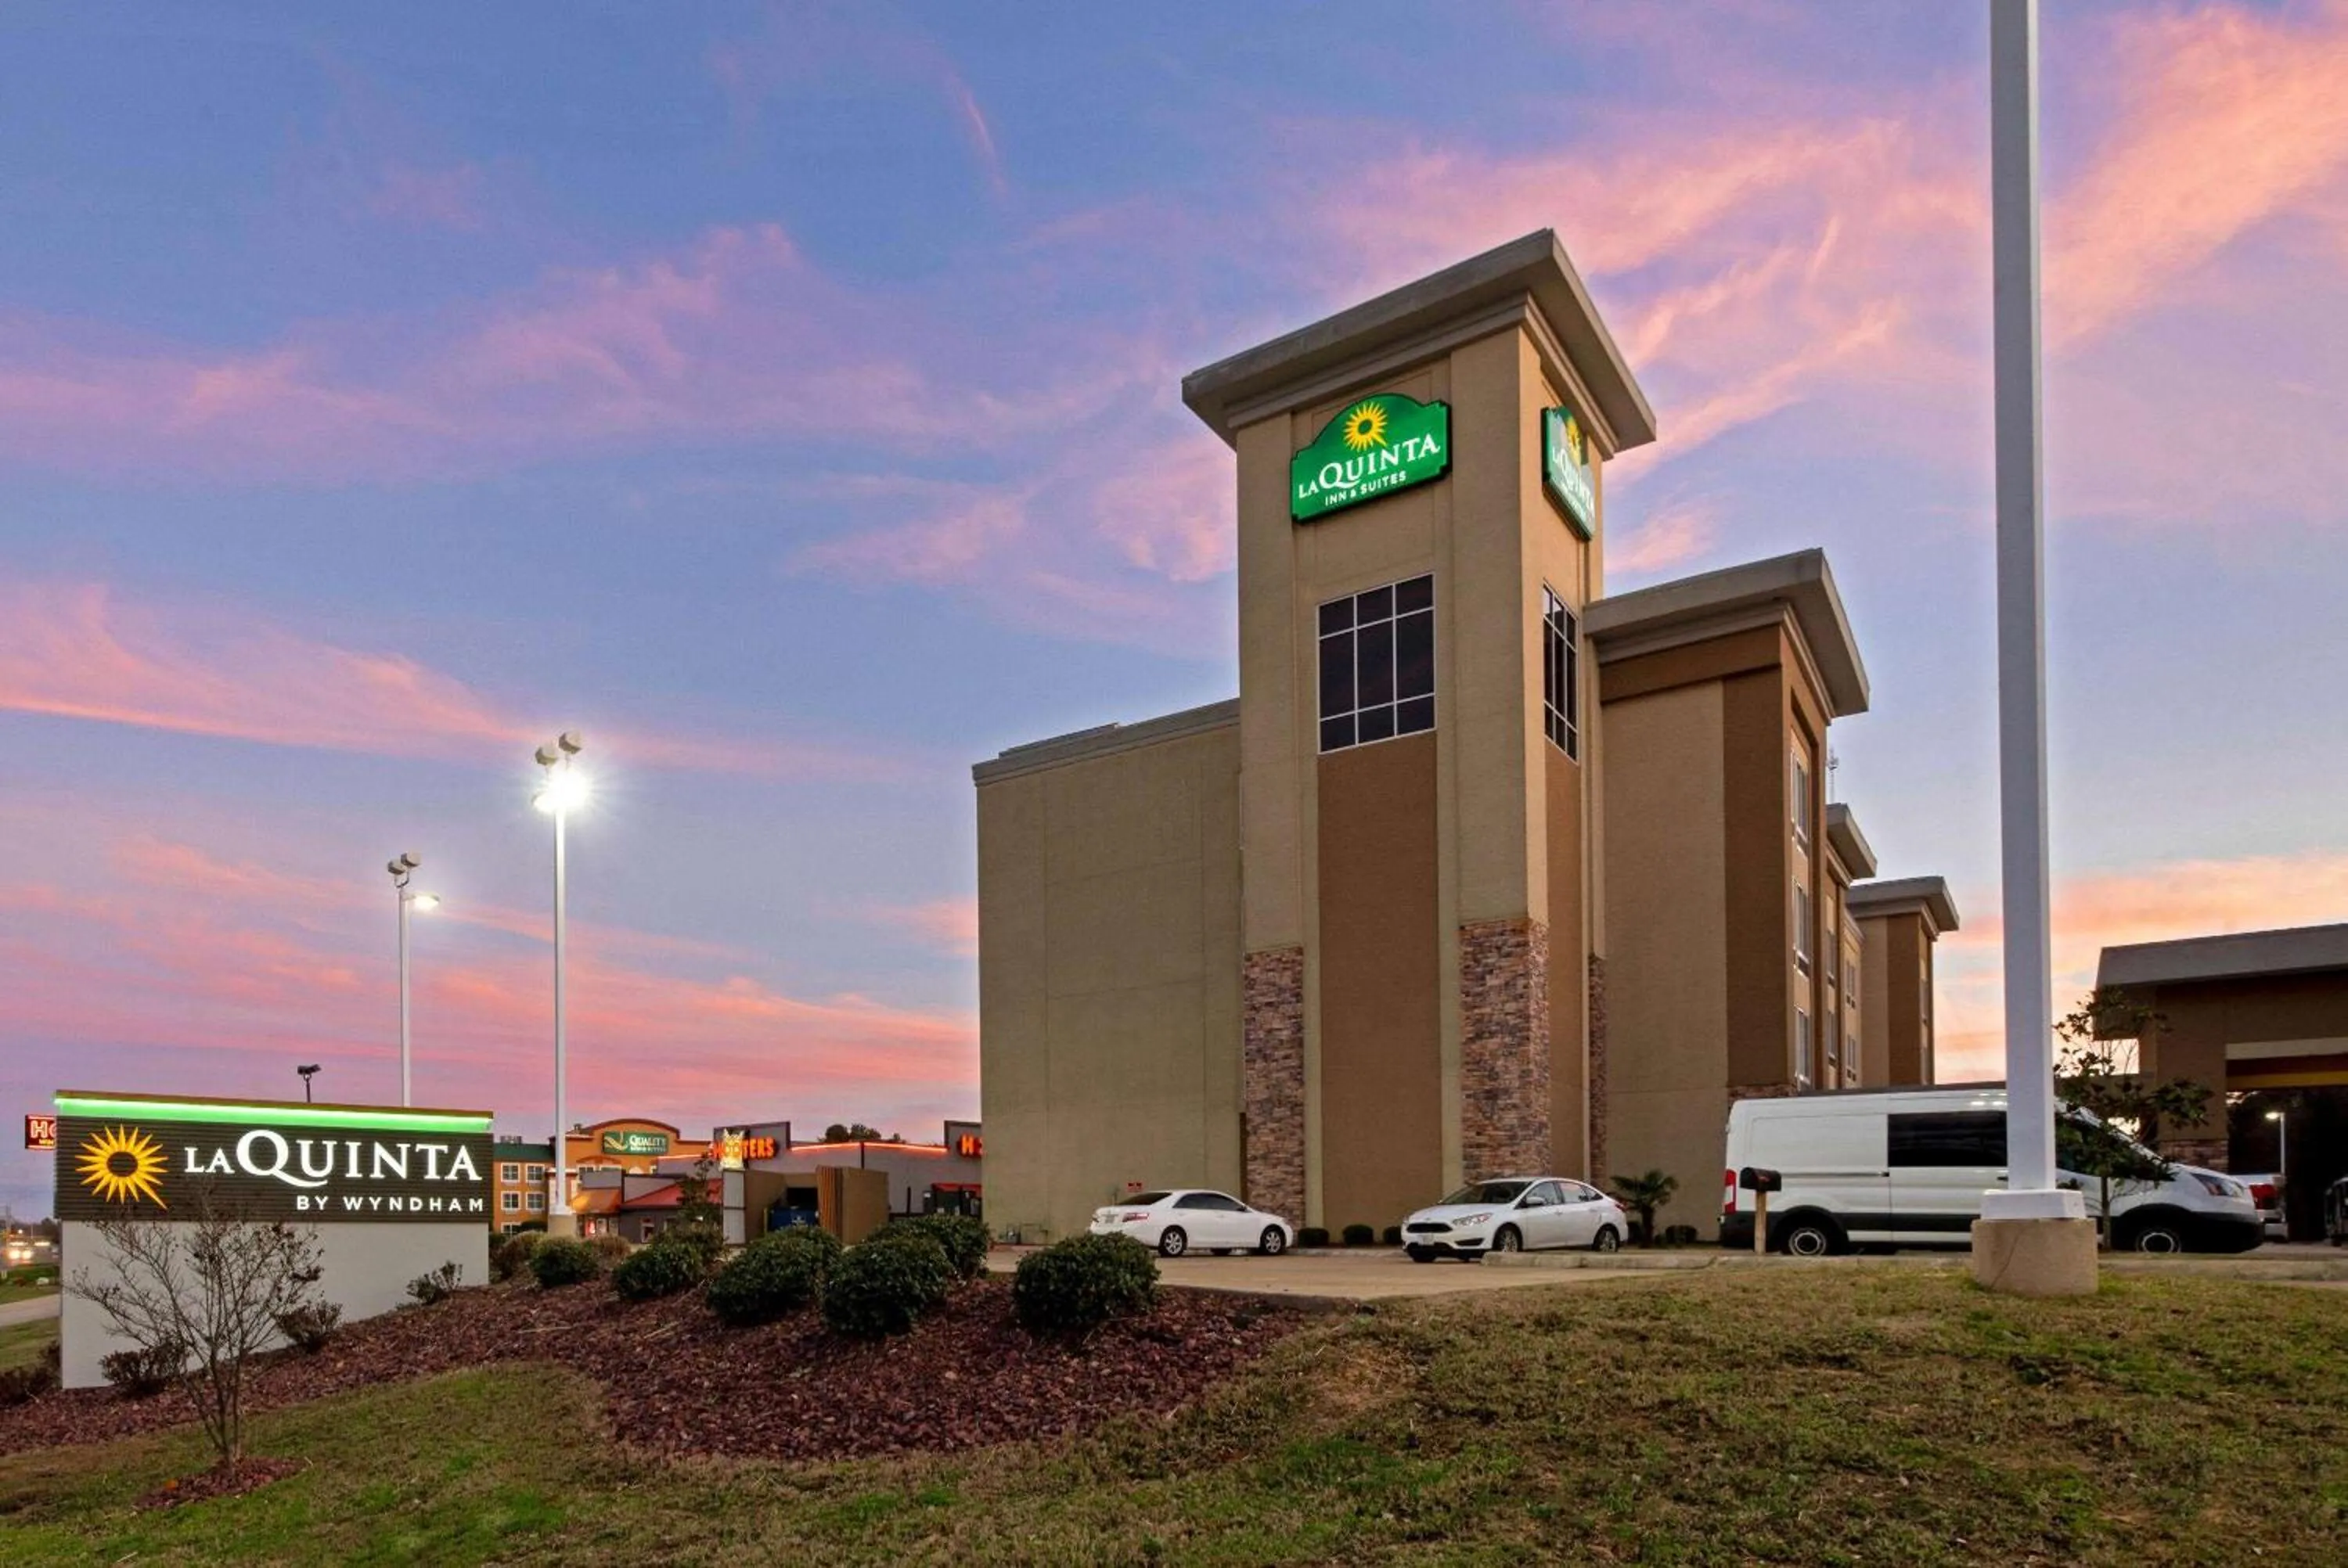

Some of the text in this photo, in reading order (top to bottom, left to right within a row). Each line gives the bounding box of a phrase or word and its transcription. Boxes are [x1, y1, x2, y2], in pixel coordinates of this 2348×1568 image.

[1298, 433, 1441, 499] LA QUINTA
[1325, 491, 1347, 506] INN
[1360, 470, 1407, 494] SUITES
[184, 1129, 483, 1188] LA QUINTA
[711, 1137, 774, 1160] HTERS
[297, 1195, 484, 1212] BY WYNDHAM
